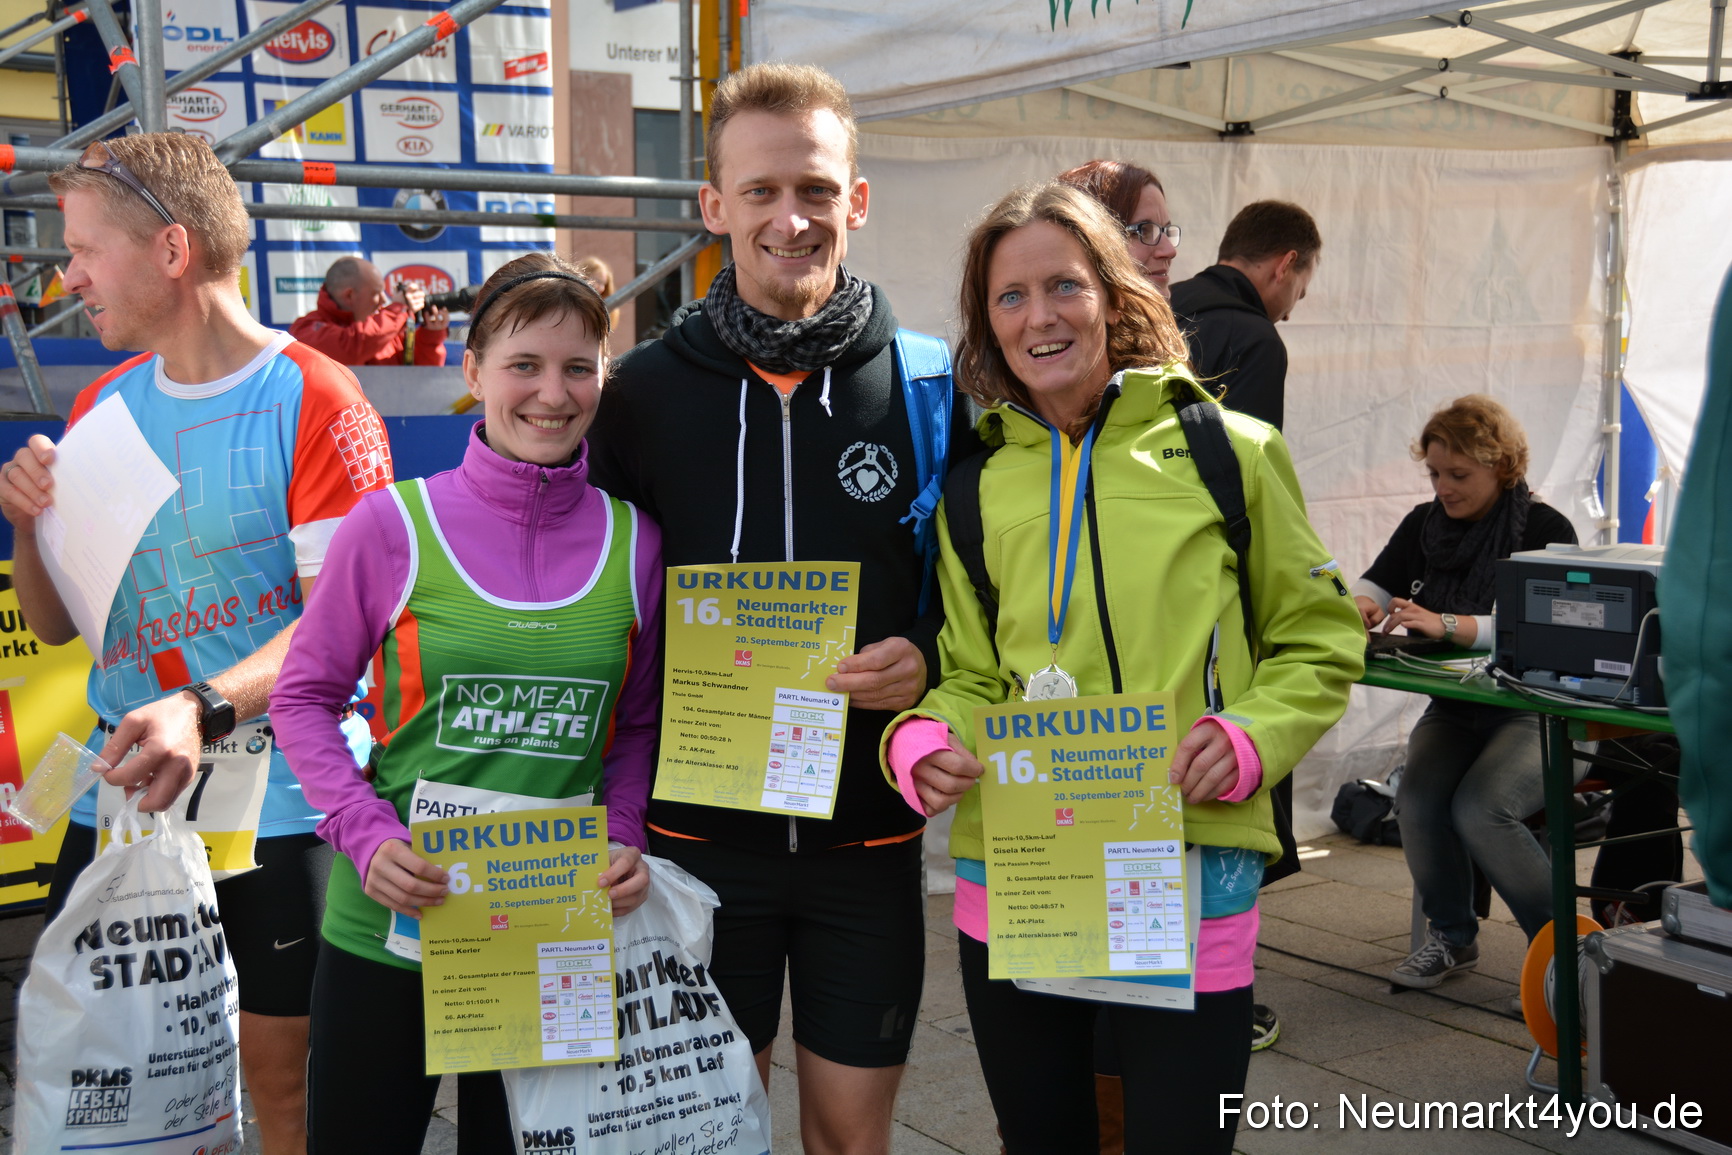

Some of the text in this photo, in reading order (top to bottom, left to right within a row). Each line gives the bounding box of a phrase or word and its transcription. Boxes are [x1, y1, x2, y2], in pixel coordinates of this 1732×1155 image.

[606, 42, 662, 62] Unterer
[166, 95, 211, 105] ERHART
[380, 104, 431, 113] GERHART
[181, 105, 220, 114] JANIG
[404, 113, 438, 122] JANIG
[508, 124, 553, 139] VARIO
[404, 141, 427, 151] KIA
[677, 571, 850, 592] URKUNDE
[676, 597, 732, 626] 16.
[737, 599, 847, 616] Neumarkter
[736, 614, 824, 634] Stadtlauf
[735, 636, 821, 650] 20. September 2015
[672, 668, 733, 677] Hervis-10,5km-Lauf
[702, 681, 749, 691] Schwandner
[457, 683, 595, 711] NO MEAT
[801, 696, 830, 704] Neumarkt
[697, 708, 735, 716] Gesamtplatz
[790, 710, 824, 721] BOCK
[451, 706, 589, 738] ATHLETE
[985, 704, 1166, 740] URKUNDE
[473, 736, 560, 749] runs on plants
[1051, 745, 1167, 763] Neumarkter
[685, 760, 724, 769] Altersklasse:
[988, 750, 1048, 784] 16.
[1052, 763, 1145, 782] Stadtlauf
[1054, 790, 1145, 801] 20. September 2015
[423, 817, 597, 853] URKUNDE
[992, 834, 1056, 842] Hervis-10,5km-Lauf
[487, 853, 599, 874] Neumarkter
[1124, 863, 1162, 872] BOCK
[437, 862, 483, 895] 6.
[488, 869, 577, 892] Stadtlauf
[489, 895, 577, 909] 20. September 2015
[556, 959, 592, 968] BOCK
[71, 1066, 133, 1087] DKMS
[148, 1063, 184, 1078] Laufen
[617, 1069, 656, 1095] 10,5
[660, 1063, 691, 1083] km
[70, 1088, 130, 1109] LEBEN
[164, 1093, 198, 1113] Oder
[588, 1090, 701, 1123] Unterstützen Sie uns.
[68, 1106, 128, 1124] SPENDEN
[164, 1114, 188, 1130] der
[589, 1123, 623, 1138] Laufen
[625, 1119, 642, 1131] für
[645, 1110, 675, 1126] einen
[678, 1101, 711, 1119] guten
[522, 1126, 576, 1149] DKMS
[654, 1133, 694, 1155] wollen
[700, 1119, 724, 1138] Sie
